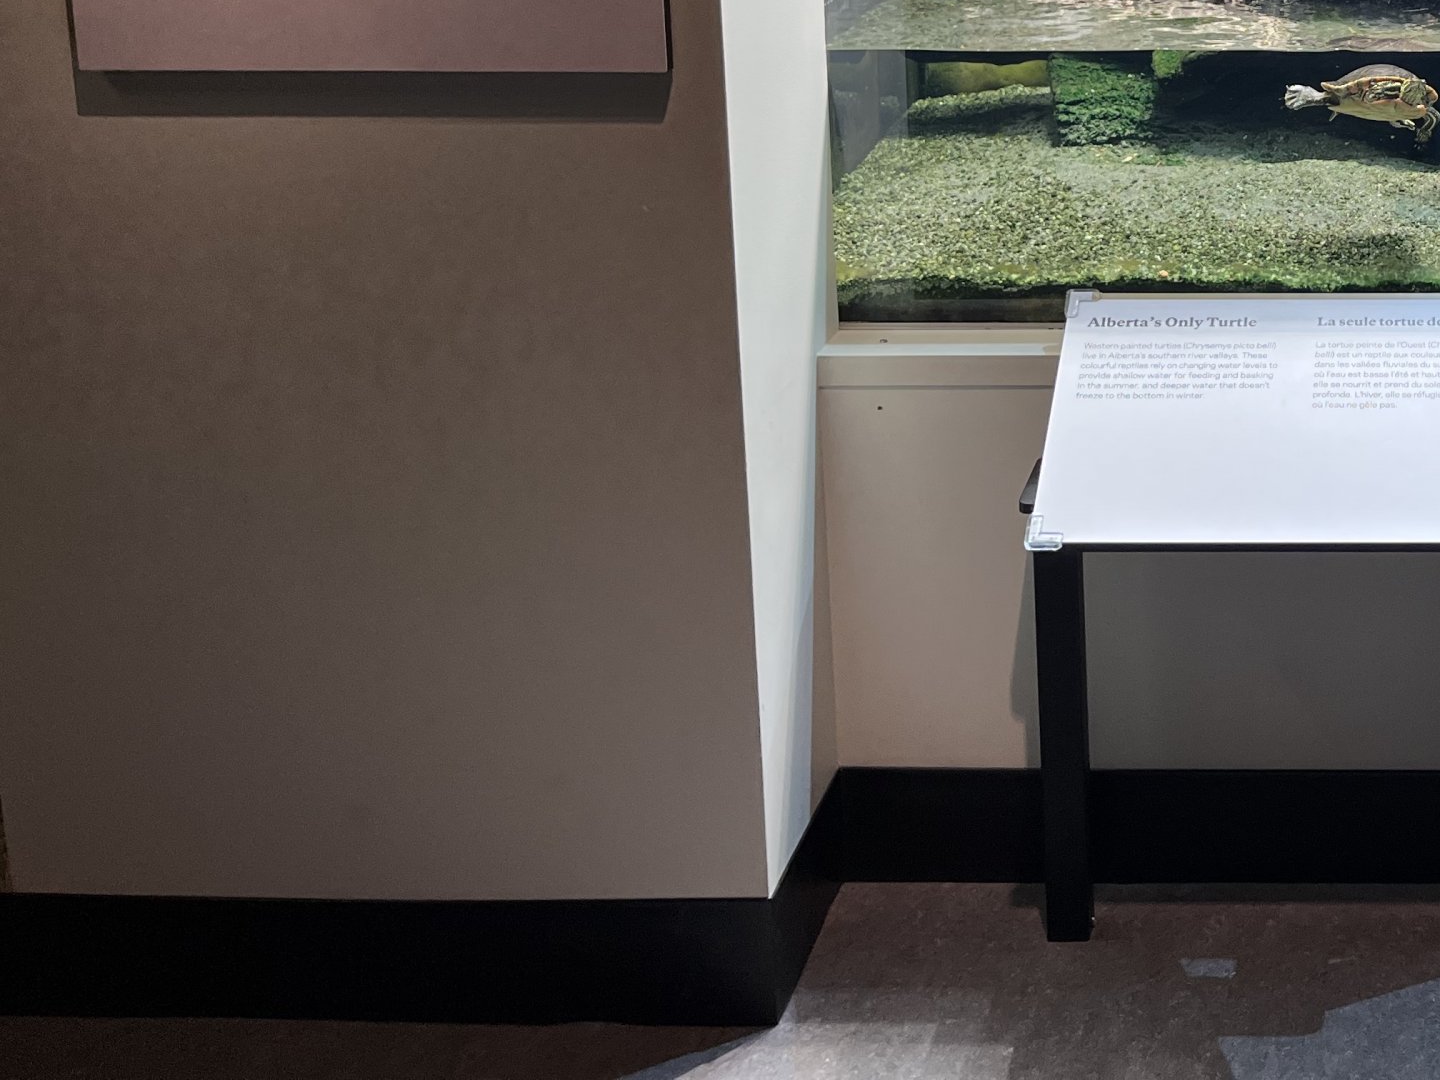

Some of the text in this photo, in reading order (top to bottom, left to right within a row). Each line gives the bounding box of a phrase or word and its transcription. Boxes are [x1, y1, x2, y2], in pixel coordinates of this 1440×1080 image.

[1088, 316, 1258, 329] Alberta's Only Turtle
[1318, 316, 1336, 327] La
[1339, 316, 1376, 327] seule
[1379, 316, 1424, 327] tortue
[1314, 360, 1335, 368] dans
[1337, 360, 1350, 368] les
[1350, 360, 1381, 368] vallées
[1382, 360, 1418, 368] fluviales
[1419, 360, 1431, 368] du
[1079, 371, 1274, 381] provide shallow water for feeding and basking
[1076, 391, 1104, 399] freeze
[1105, 391, 1115, 399] to
[1116, 391, 1131, 399] the
[1132, 391, 1165, 399] bottom
[1166, 391, 1174, 399] in
